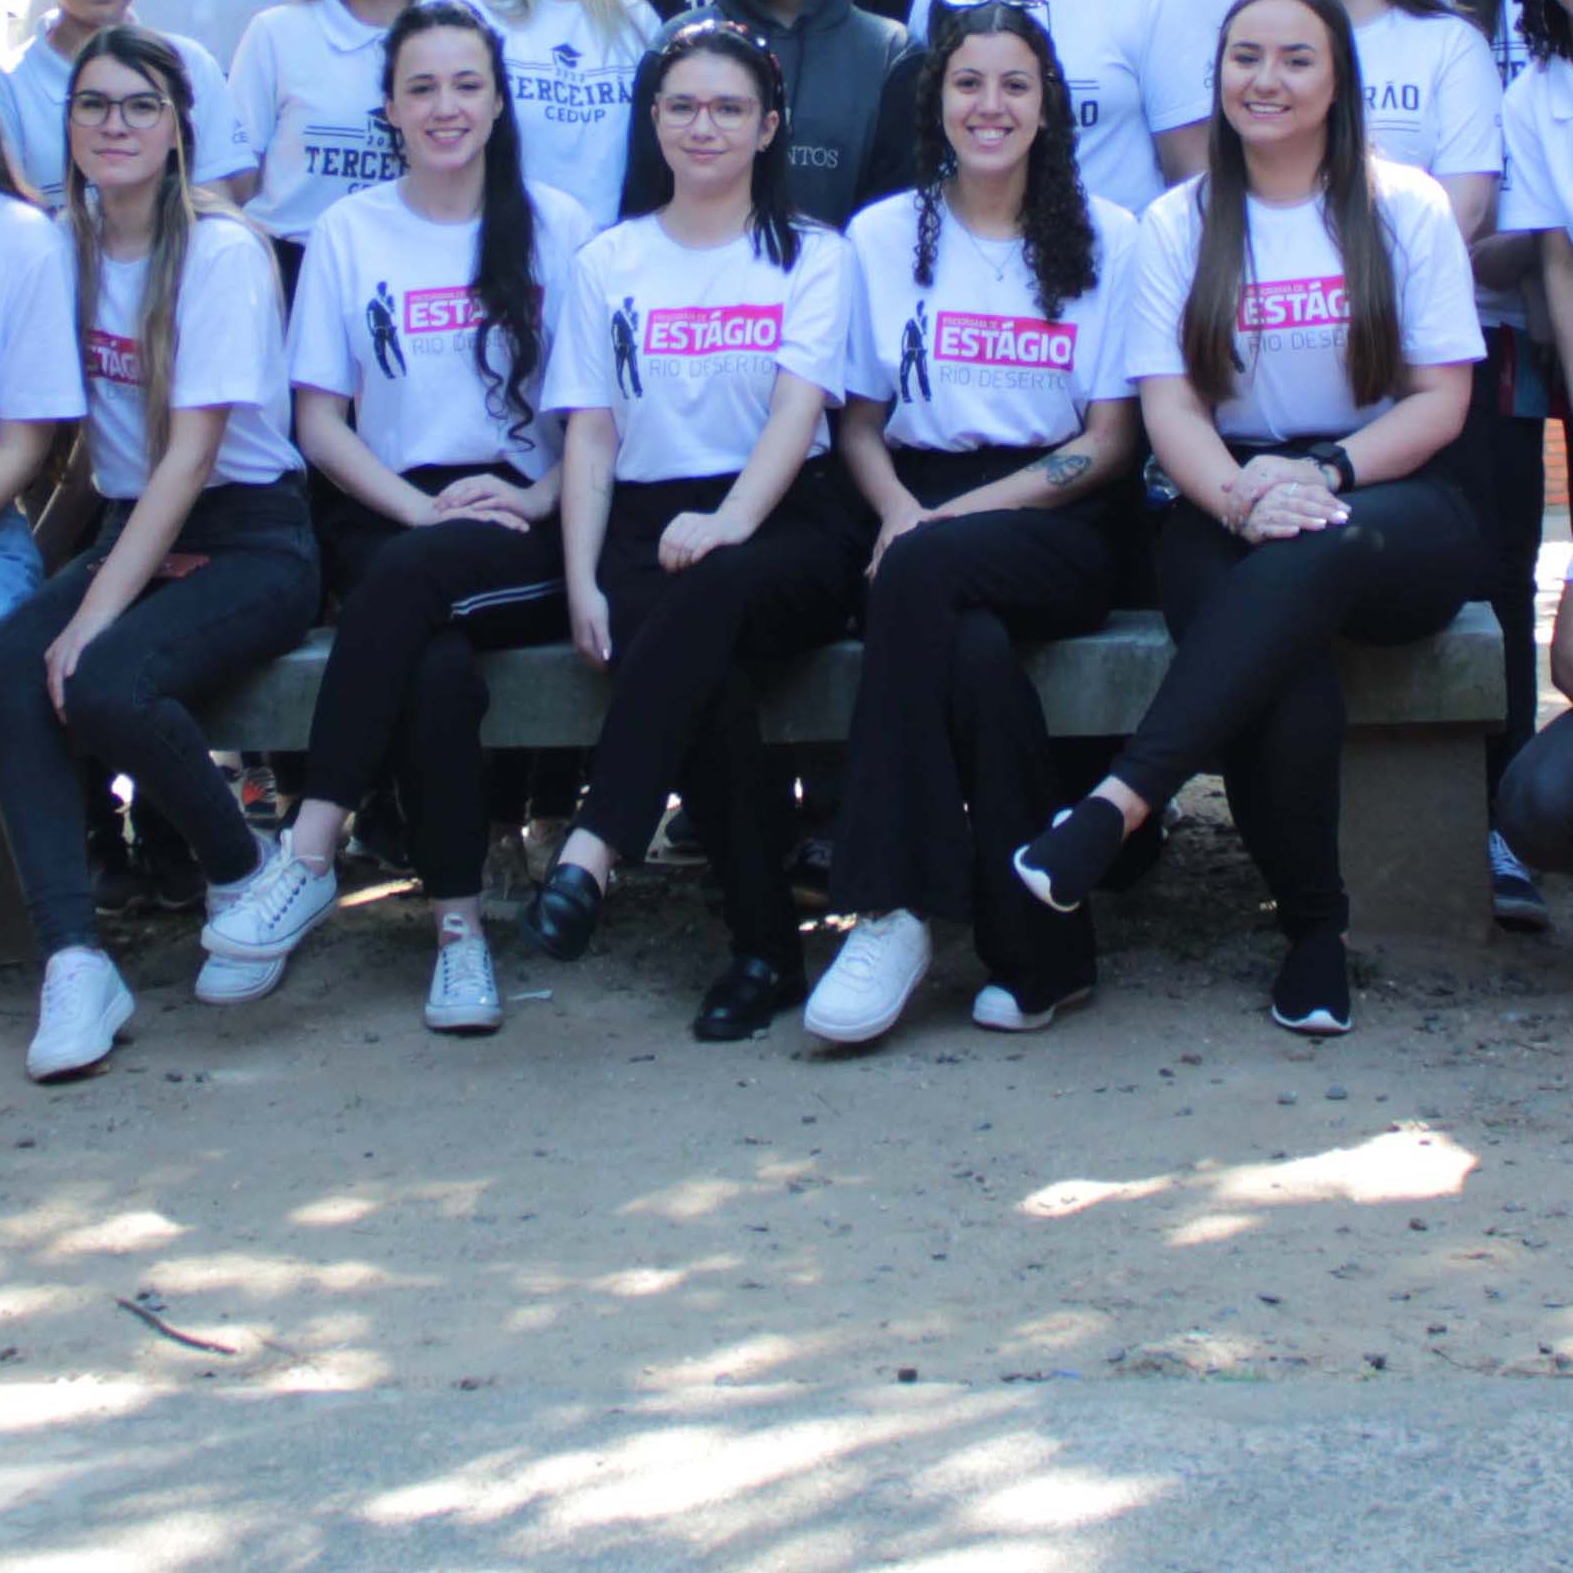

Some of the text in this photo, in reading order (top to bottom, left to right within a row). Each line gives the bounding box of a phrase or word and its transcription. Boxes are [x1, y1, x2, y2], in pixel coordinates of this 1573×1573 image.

[508, 74, 633, 107] ERCEIRÃ
[1244, 281, 1351, 325] ESTÁG
[650, 311, 777, 351] ESTÁGIO
[940, 321, 1072, 364] ESTÁGIO
